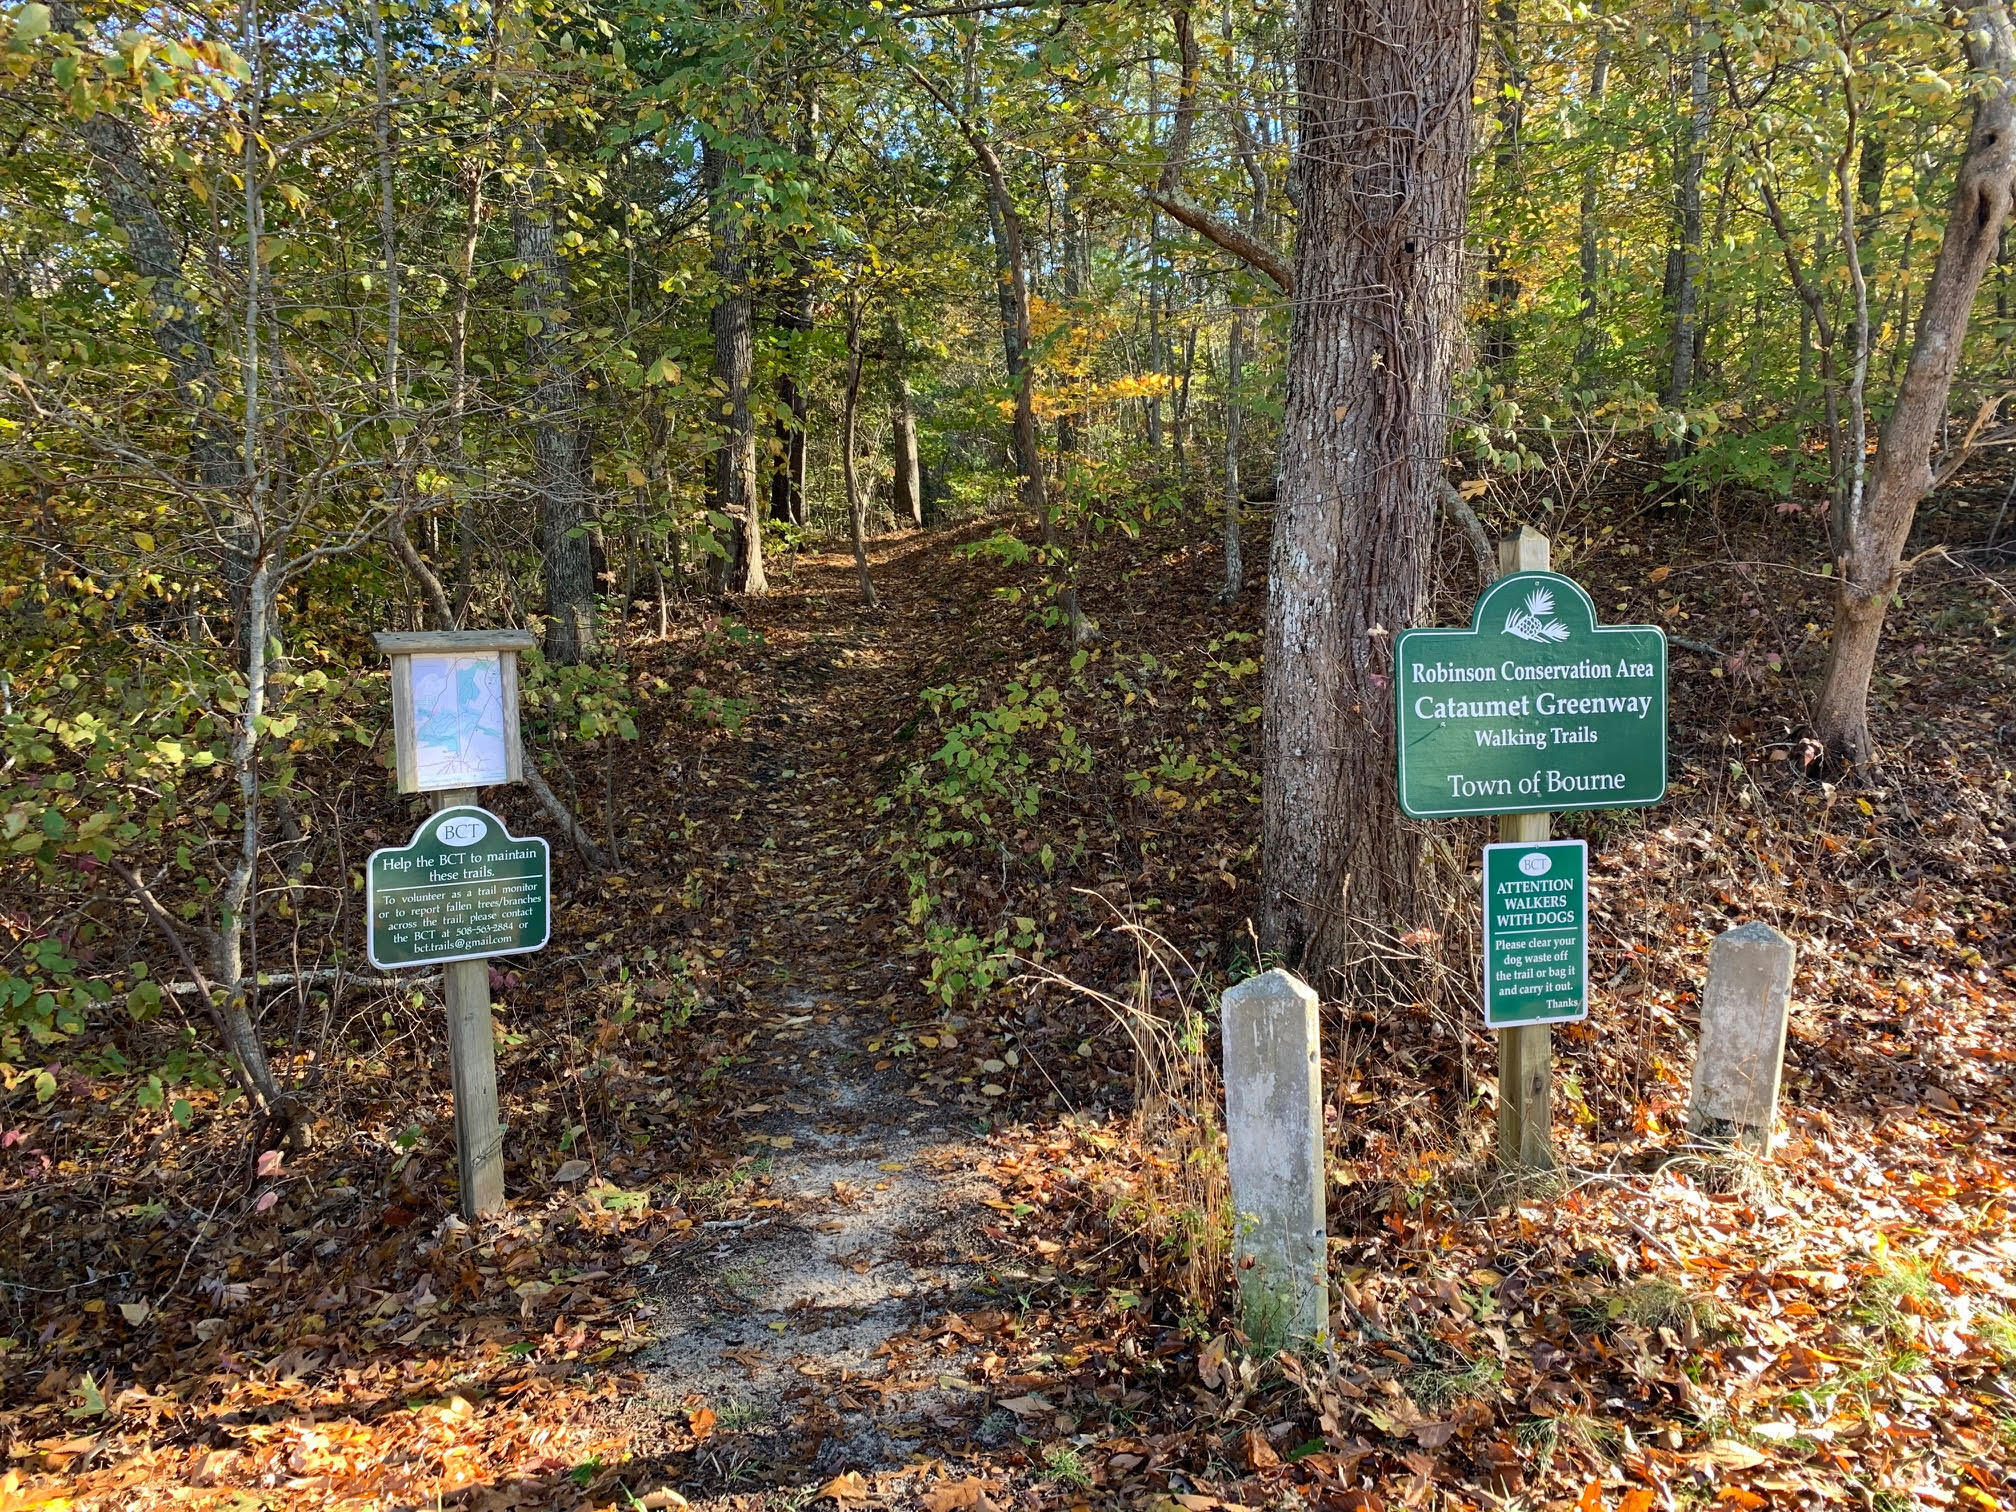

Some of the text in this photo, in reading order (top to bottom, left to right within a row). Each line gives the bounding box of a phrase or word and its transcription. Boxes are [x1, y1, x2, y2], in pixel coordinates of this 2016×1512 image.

[1412, 658, 1654, 683] Robinson Conservation Area
[1415, 692, 1652, 719] Cataumet Greenway
[1475, 727, 1598, 749] Walking Trails
[1448, 770, 1626, 797] Town of Bourne
[445, 824, 480, 839] BCT
[383, 849, 536, 872] Help the BCT to maintain
[1524, 859, 1546, 870] BCT
[429, 866, 495, 881] these trails.
[383, 895, 395, 905] To
[402, 891, 445, 903] volunteer
[451, 891, 461, 899] as
[478, 886, 496, 895] trail
[502, 883, 537, 893] monitor
[1497, 879, 1574, 894] ATTENTION
[379, 895, 541, 919] or to report fallen trees/branches
[1504, 895, 1567, 910] WALKERS
[388, 921, 417, 931] across
[423, 918, 437, 927] the
[470, 913, 496, 924] please
[502, 908, 533, 918] contact
[1497, 911, 1574, 927] WITH DOGS
[393, 933, 408, 943] the
[415, 930, 435, 941] BCT
[441, 929, 450, 938] at
[456, 923, 513, 936] 508-563-2884
[414, 935, 512, 953] bct.trails@gmail.com
[1495, 937, 1575, 950] Please clear your
[1504, 950, 1568, 967] dog waste off
[1496, 966, 1575, 981] the trail or bag it
[1499, 981, 1573, 996] and carry it out.
